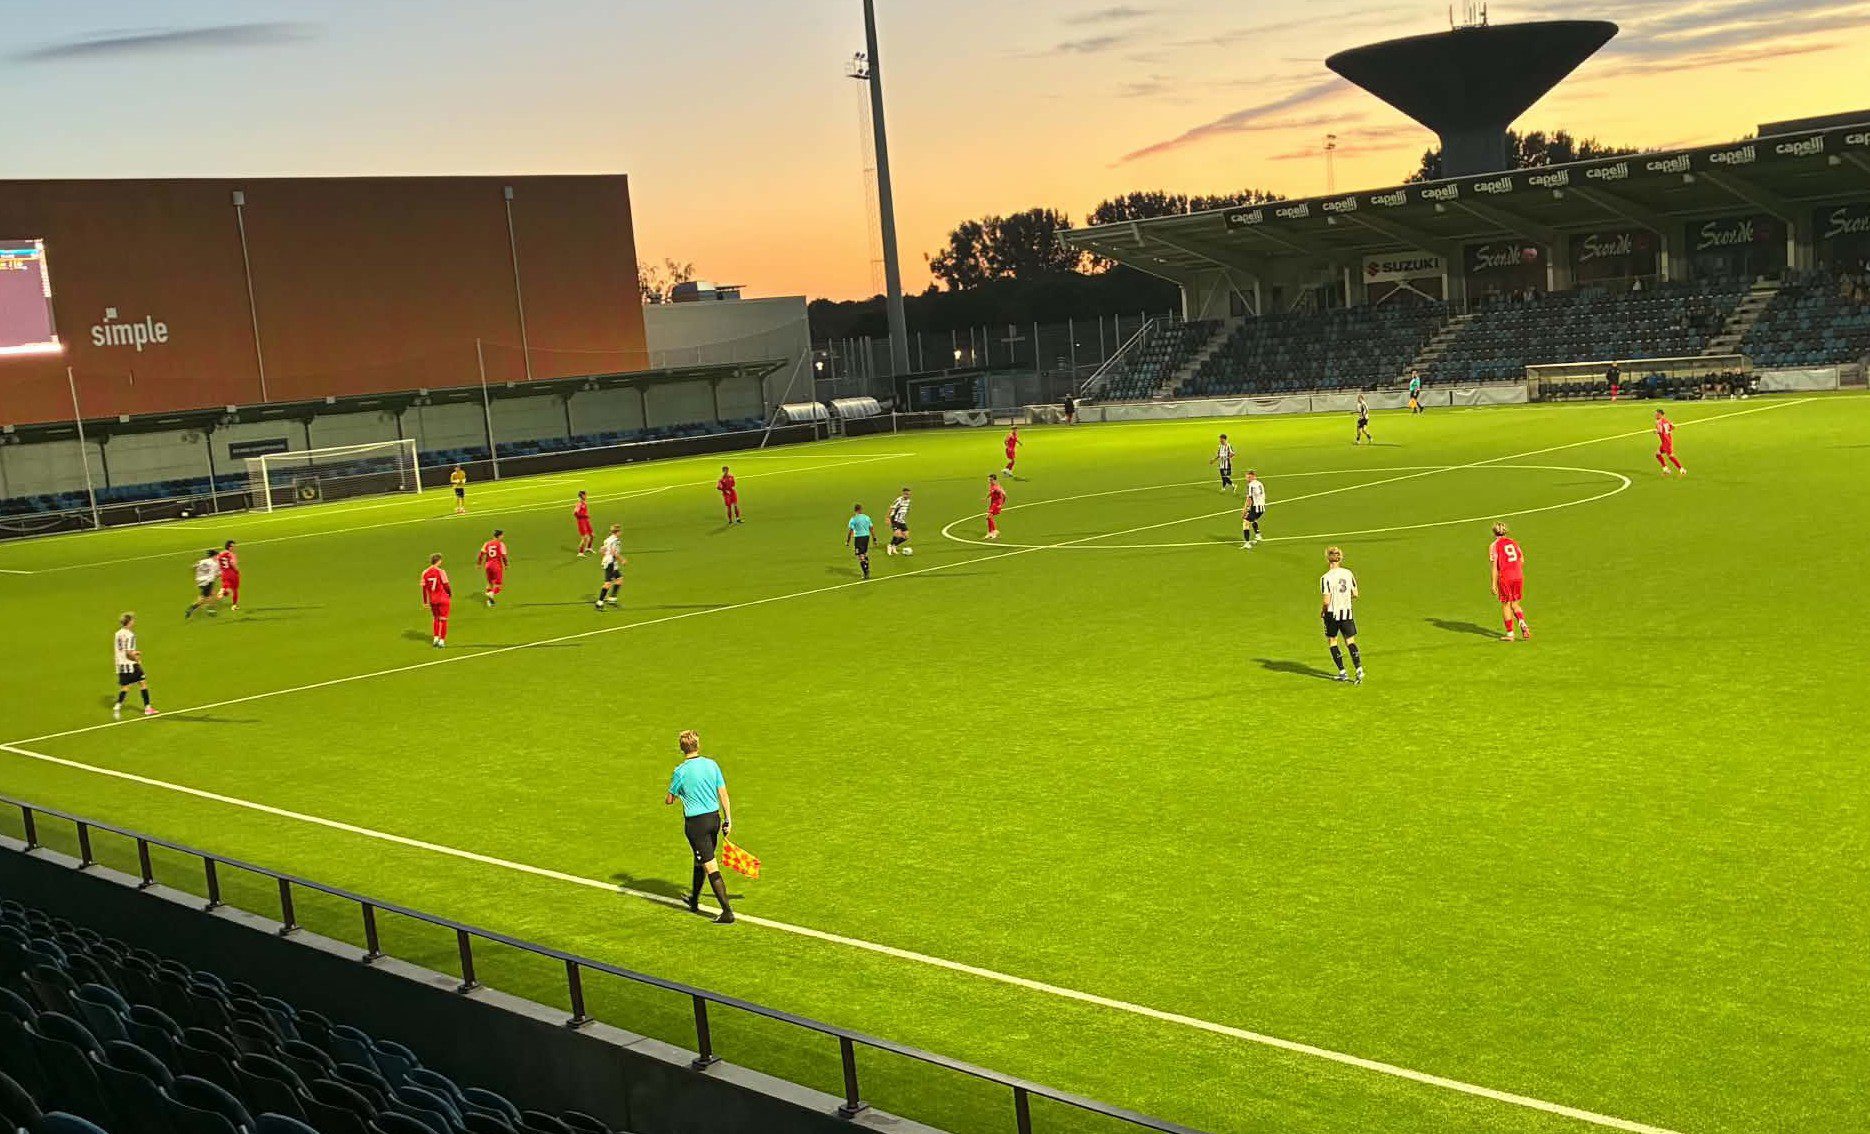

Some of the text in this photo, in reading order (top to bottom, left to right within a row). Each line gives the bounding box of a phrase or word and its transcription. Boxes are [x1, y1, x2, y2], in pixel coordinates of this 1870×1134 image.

[1775, 135, 1824, 155] capelli
[1646, 154, 1690, 173] capelli
[1709, 145, 1756, 165] capelli
[1528, 169, 1569, 187] capelli
[1585, 162, 1629, 181] capelli
[1421, 184, 1458, 201] capelli
[1473, 177, 1513, 194] capelli
[1370, 191, 1407, 207] capelli
[1382, 257, 1440, 273] SUZUKI
[91, 314, 169, 352] simple
[1504, 543, 1518, 562] 9
[427, 577, 438, 591] 7
[1338, 578, 1347, 593] 3
